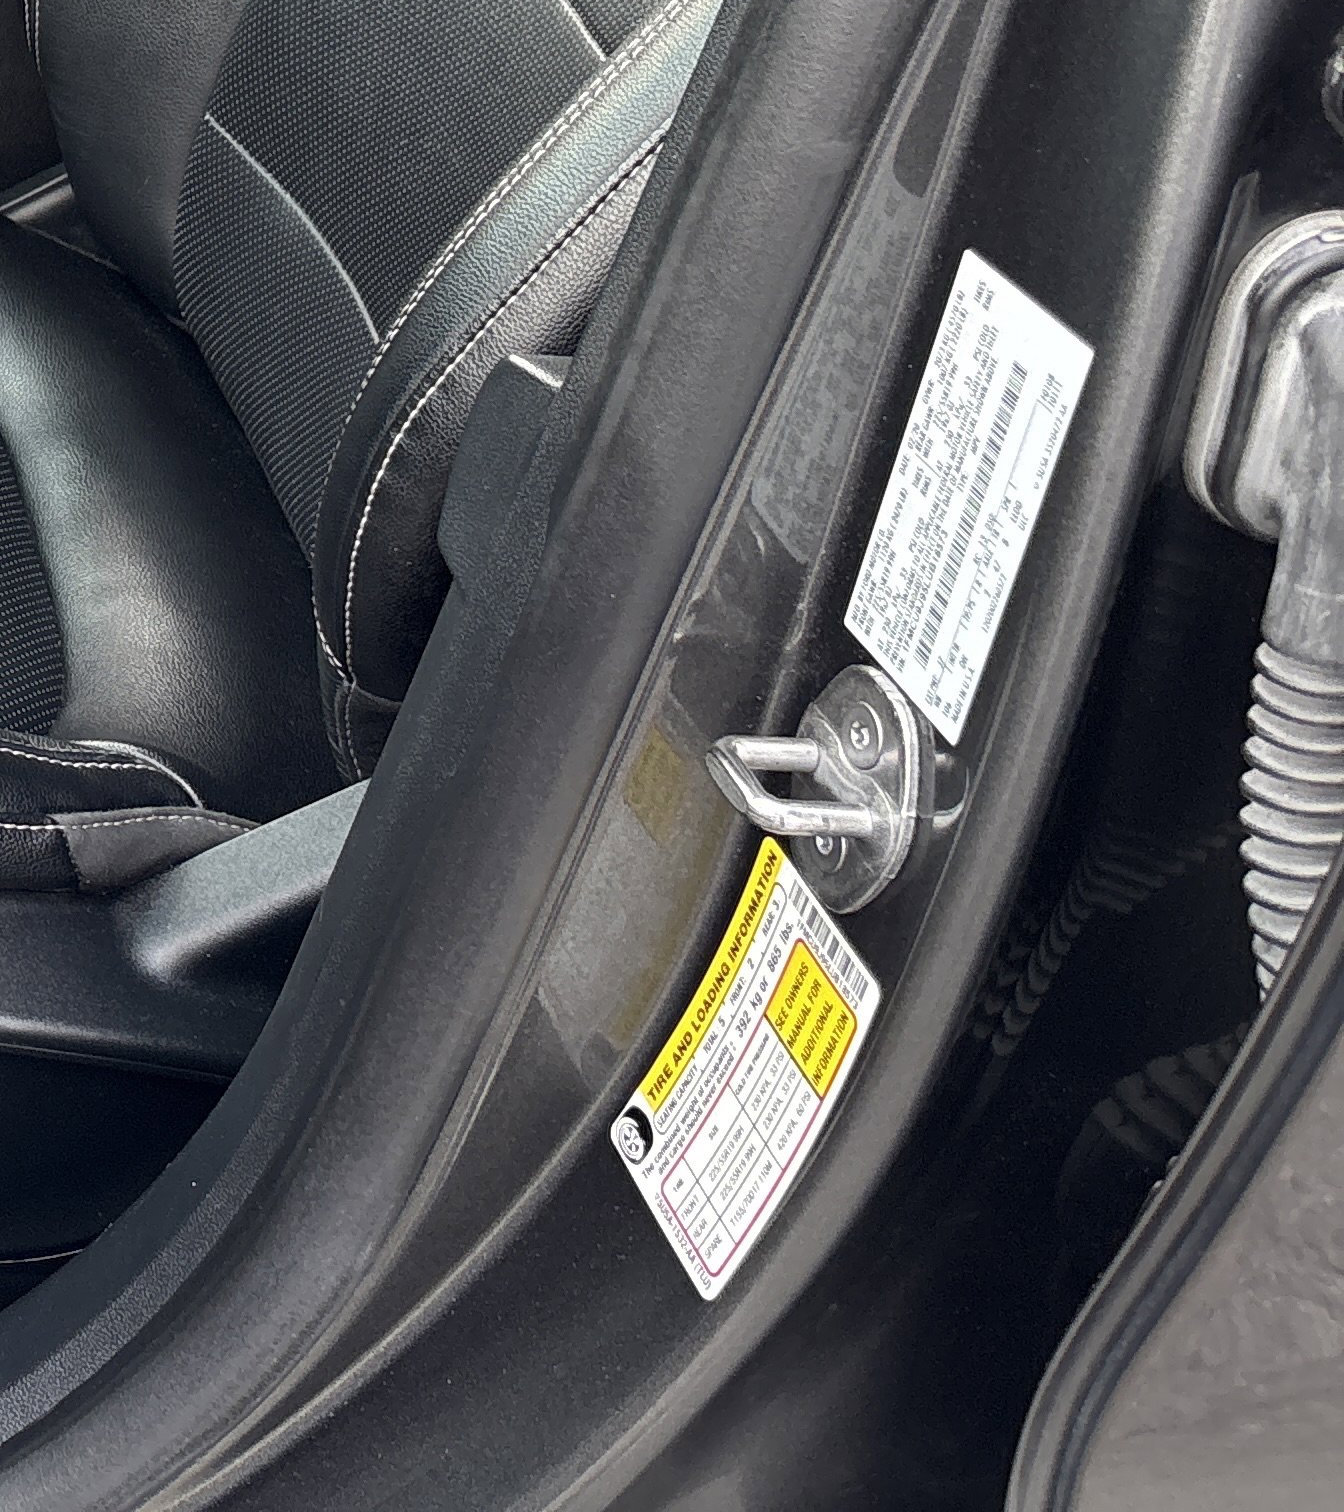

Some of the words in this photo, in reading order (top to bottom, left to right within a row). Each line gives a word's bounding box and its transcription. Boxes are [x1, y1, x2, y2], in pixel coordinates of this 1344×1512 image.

[647, 1062, 673, 1103] TIRE
[670, 1028, 693, 1067] AND
[690, 960, 730, 1032] LOADING
[727, 848, 777, 963] INFORMATION
[734, 1008, 751, 1039] 392
[748, 988, 763, 1012] kg
[758, 975, 769, 993] or
[766, 943, 782, 973] 865
[774, 1005, 788, 1032] SEE
[784, 960, 809, 1011] OWNERS
[786, 999, 811, 1049] MANUAL
[807, 977, 821, 1005] FOR
[656, 1096, 677, 1129] SEATING
[675, 1062, 698, 1100] CAPACITY
[717, 1014, 725, 1028] 5
[746, 956, 755, 970] 2
[799, 996, 833, 1066] ADDITIONAL
[811, 1009, 849, 1087] INFORMATION
[642, 1160, 654, 1179] The
[654, 1122, 681, 1164] combined
[679, 1094, 700, 1126] weight
[696, 1084, 704, 1098] of
[658, 1156, 669, 1176] and
[668, 1133, 686, 1160] cargo
[684, 1104, 702, 1137] should
[701, 1081, 717, 1108] never
[715, 1051, 734, 1085] exceed
